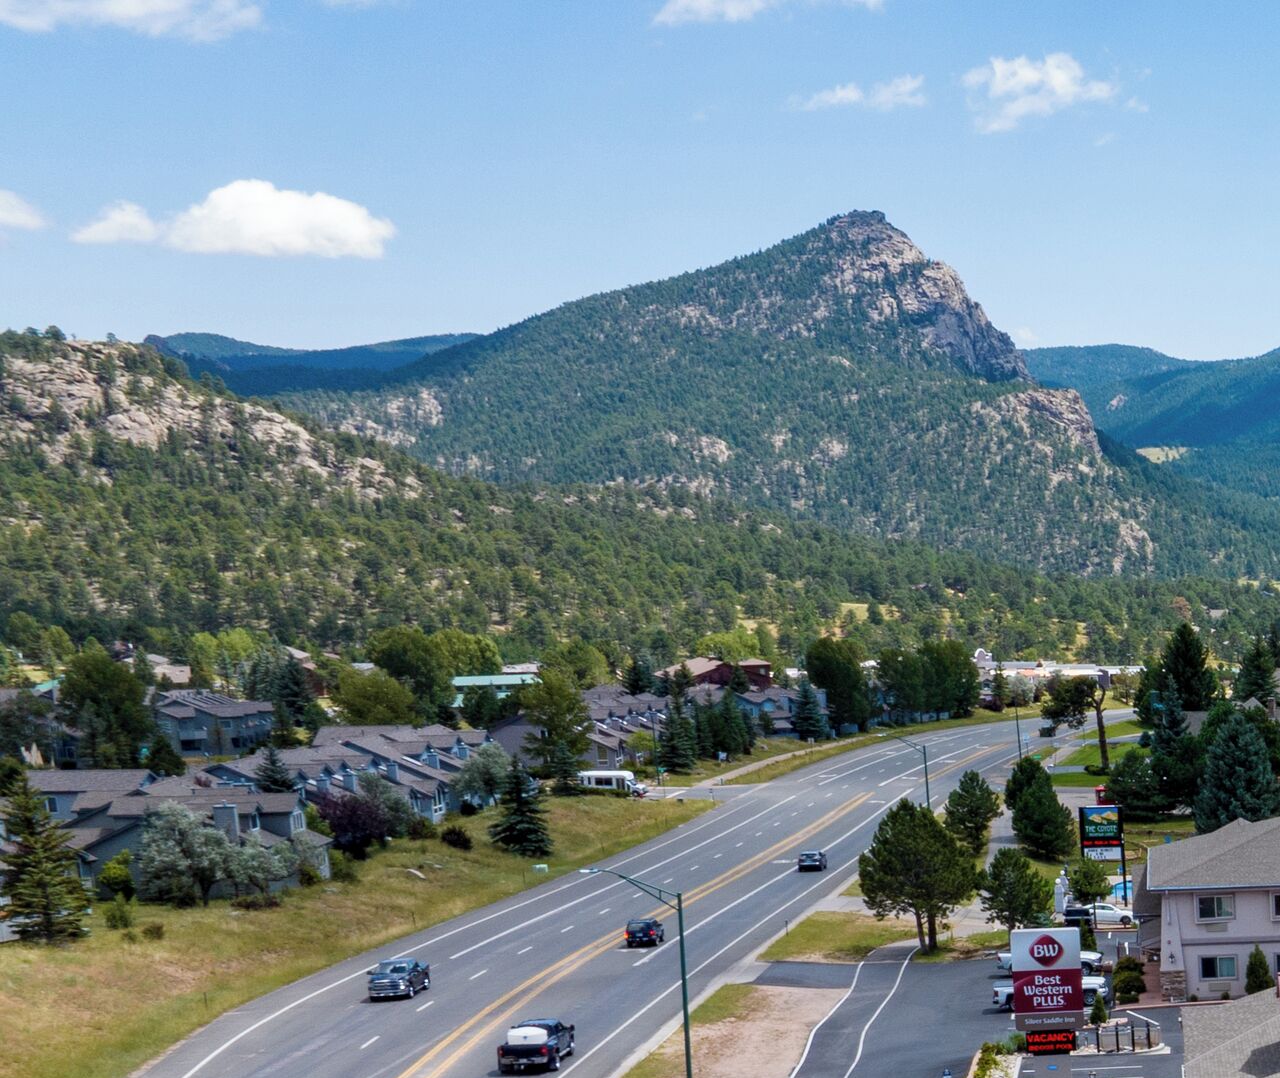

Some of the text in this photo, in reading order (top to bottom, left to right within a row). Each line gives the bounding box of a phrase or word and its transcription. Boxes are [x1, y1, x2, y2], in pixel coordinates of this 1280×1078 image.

[1033, 944, 1059, 958] BW
[1034, 974, 1061, 985] Best
[1023, 985, 1073, 996] Western
[1033, 995, 1065, 1006] PLUS
[1043, 1016, 1064, 1024] Saddle
[1027, 1032, 1074, 1043] VACANCY
